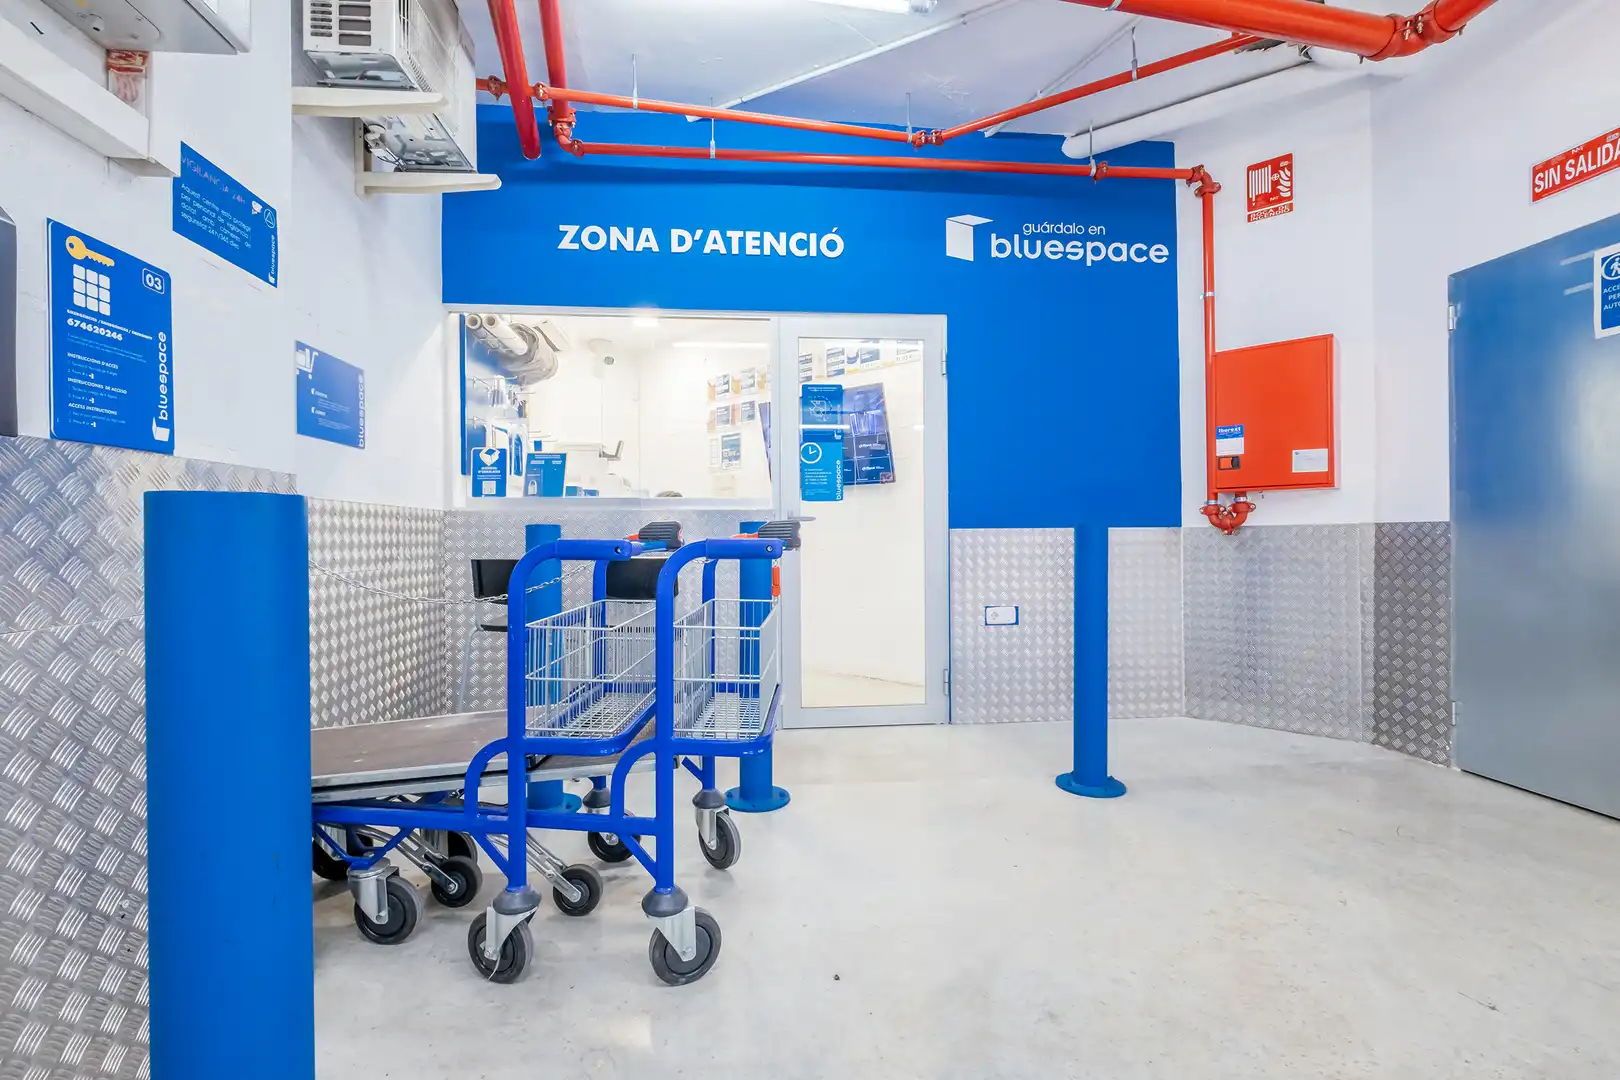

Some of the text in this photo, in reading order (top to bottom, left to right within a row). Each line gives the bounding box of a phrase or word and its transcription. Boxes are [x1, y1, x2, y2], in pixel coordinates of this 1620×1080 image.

[1534, 165, 1561, 193] SIN
[557, 224, 660, 252] ZONA
[1022, 221, 1106, 235] guárdalo en
[990, 233, 1170, 266] bluespace
[146, 273, 162, 290] 03
[66, 318, 123, 341] 674620246
[158, 331, 169, 420] bluespace
[68, 402, 118, 415] ACCESS INSTRUCTIONS
